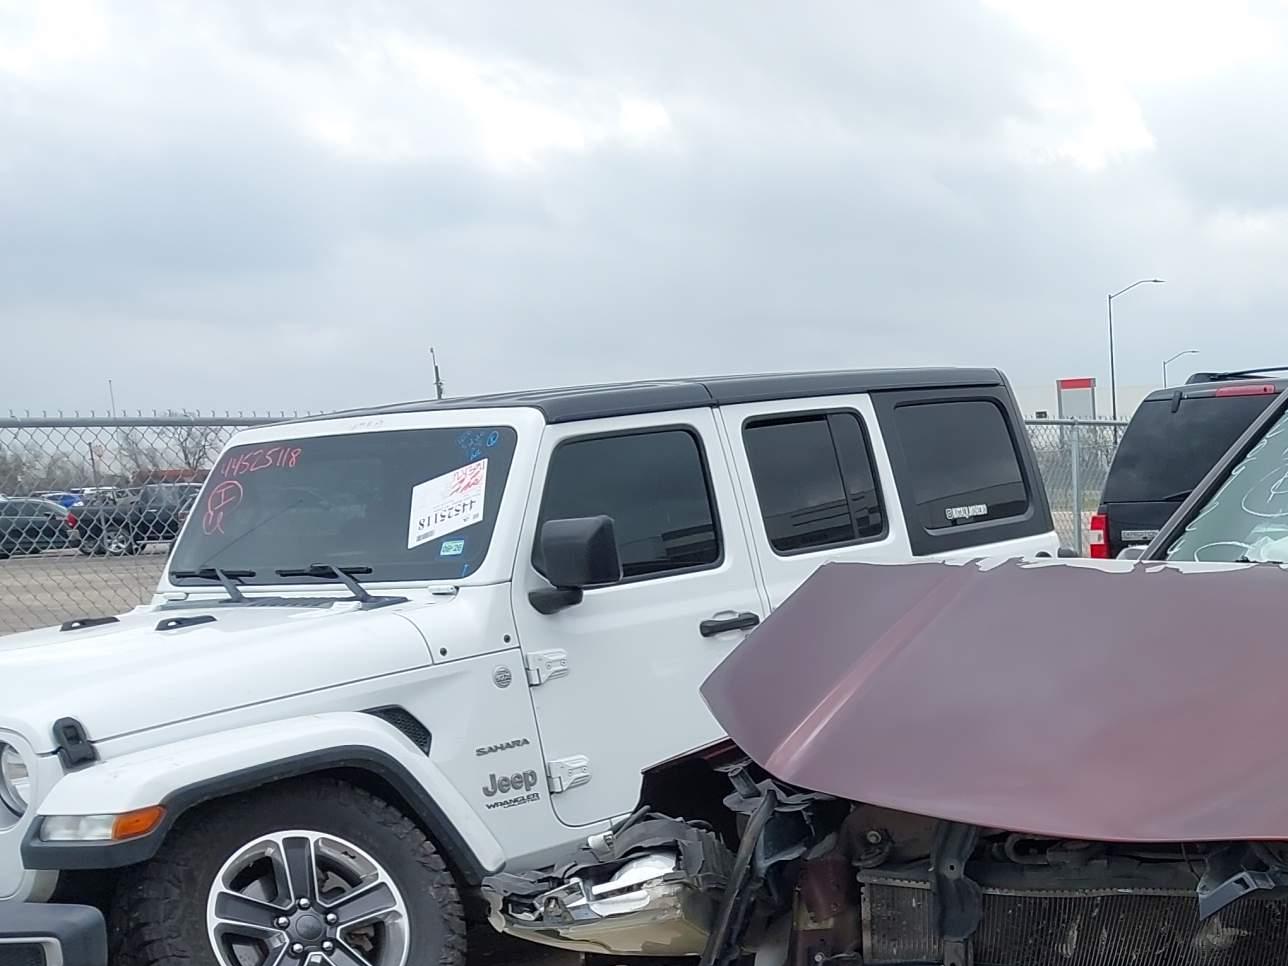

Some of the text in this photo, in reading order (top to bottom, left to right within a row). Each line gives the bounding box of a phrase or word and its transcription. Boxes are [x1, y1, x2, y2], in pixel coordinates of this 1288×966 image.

[220, 447, 302, 477] 44525118
[475, 738, 531, 757] SAHARA
[481, 769, 538, 798] Jeep
[485, 792, 541, 810] WRANGLER
